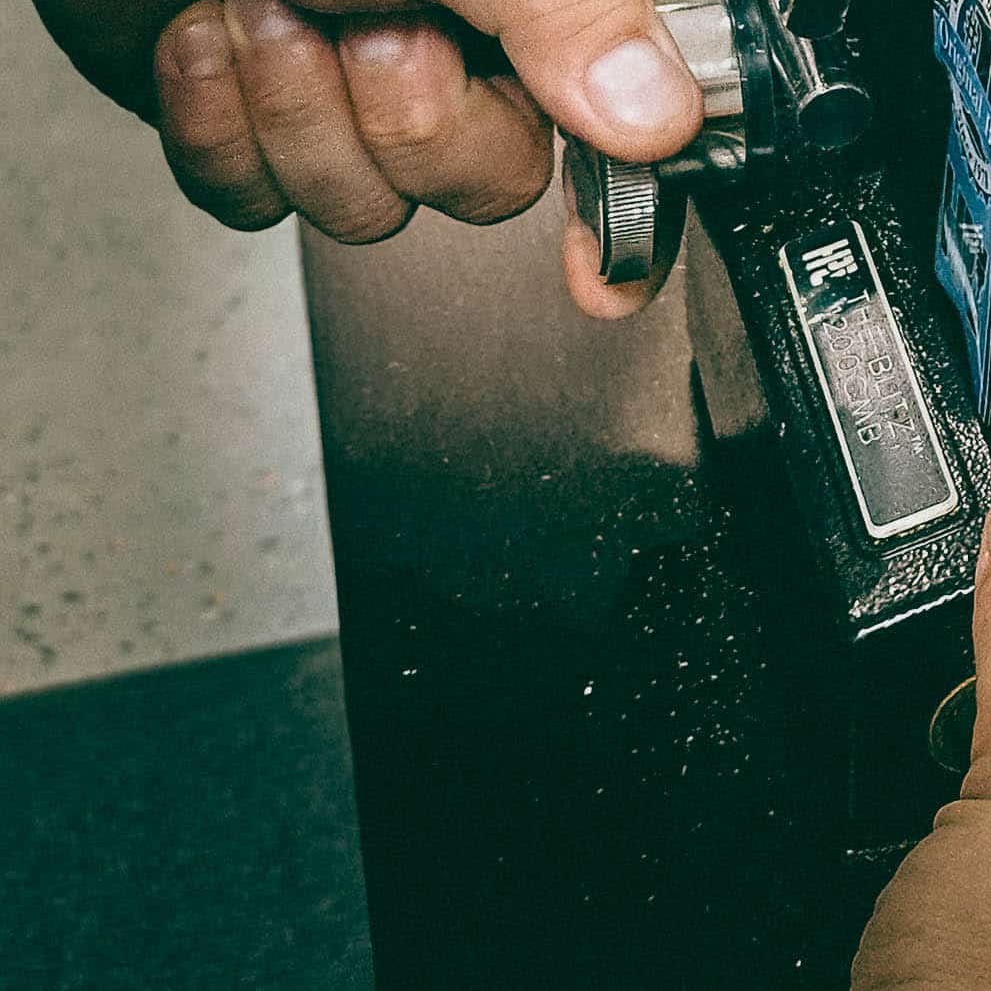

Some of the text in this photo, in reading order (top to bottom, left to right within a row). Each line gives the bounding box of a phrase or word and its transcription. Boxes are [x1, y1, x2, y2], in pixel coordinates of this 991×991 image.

[939, 16, 984, 119] Original
[801, 235, 858, 290] HPC
[844, 289, 885, 351] THE
